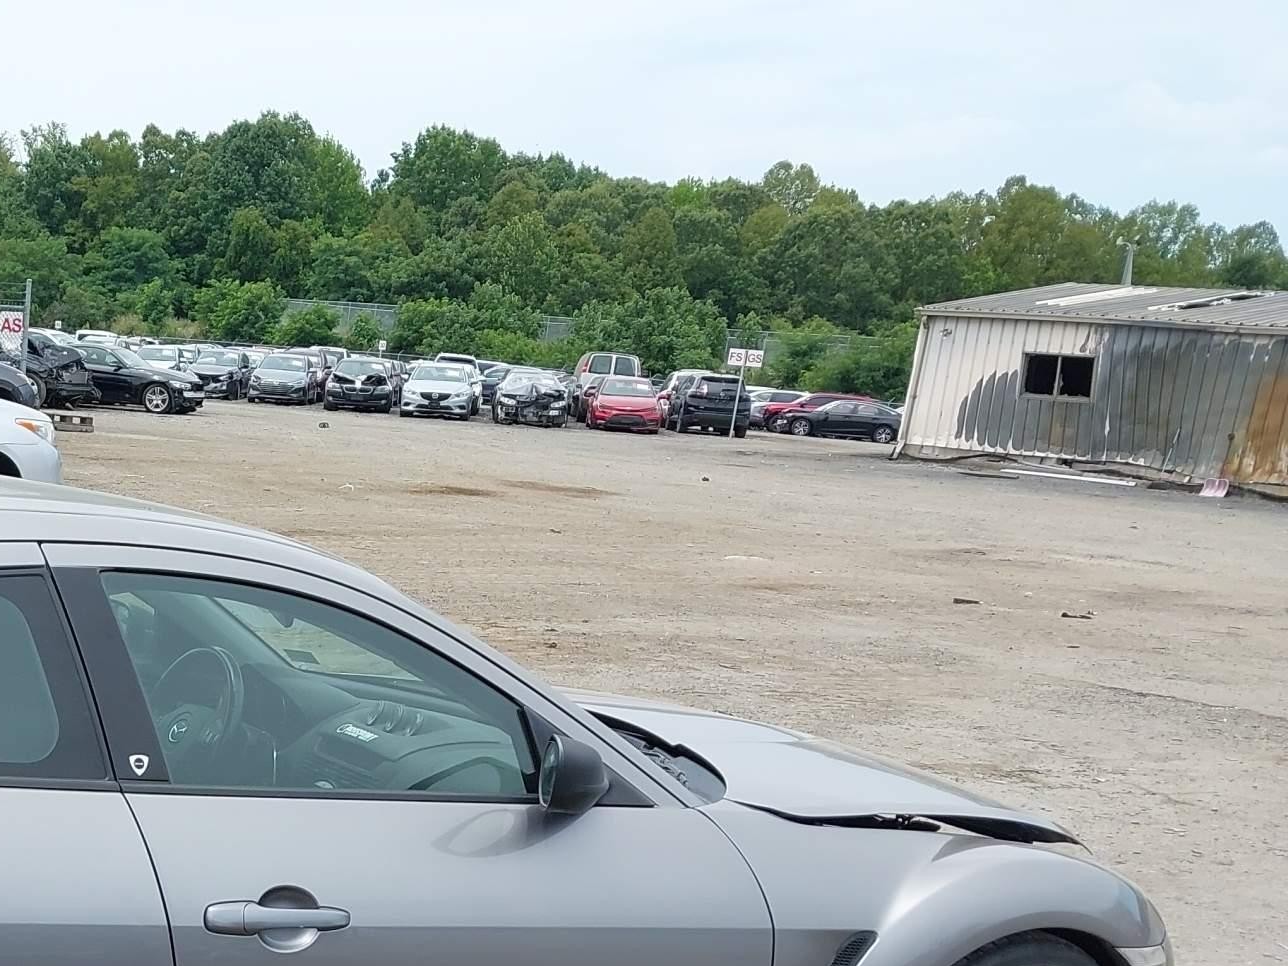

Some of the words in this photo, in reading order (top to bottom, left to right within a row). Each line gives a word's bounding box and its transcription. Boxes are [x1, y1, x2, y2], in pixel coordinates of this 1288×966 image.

[0, 318, 22, 333] AS
[729, 352, 743, 362] FS
[747, 353, 762, 364] GS
